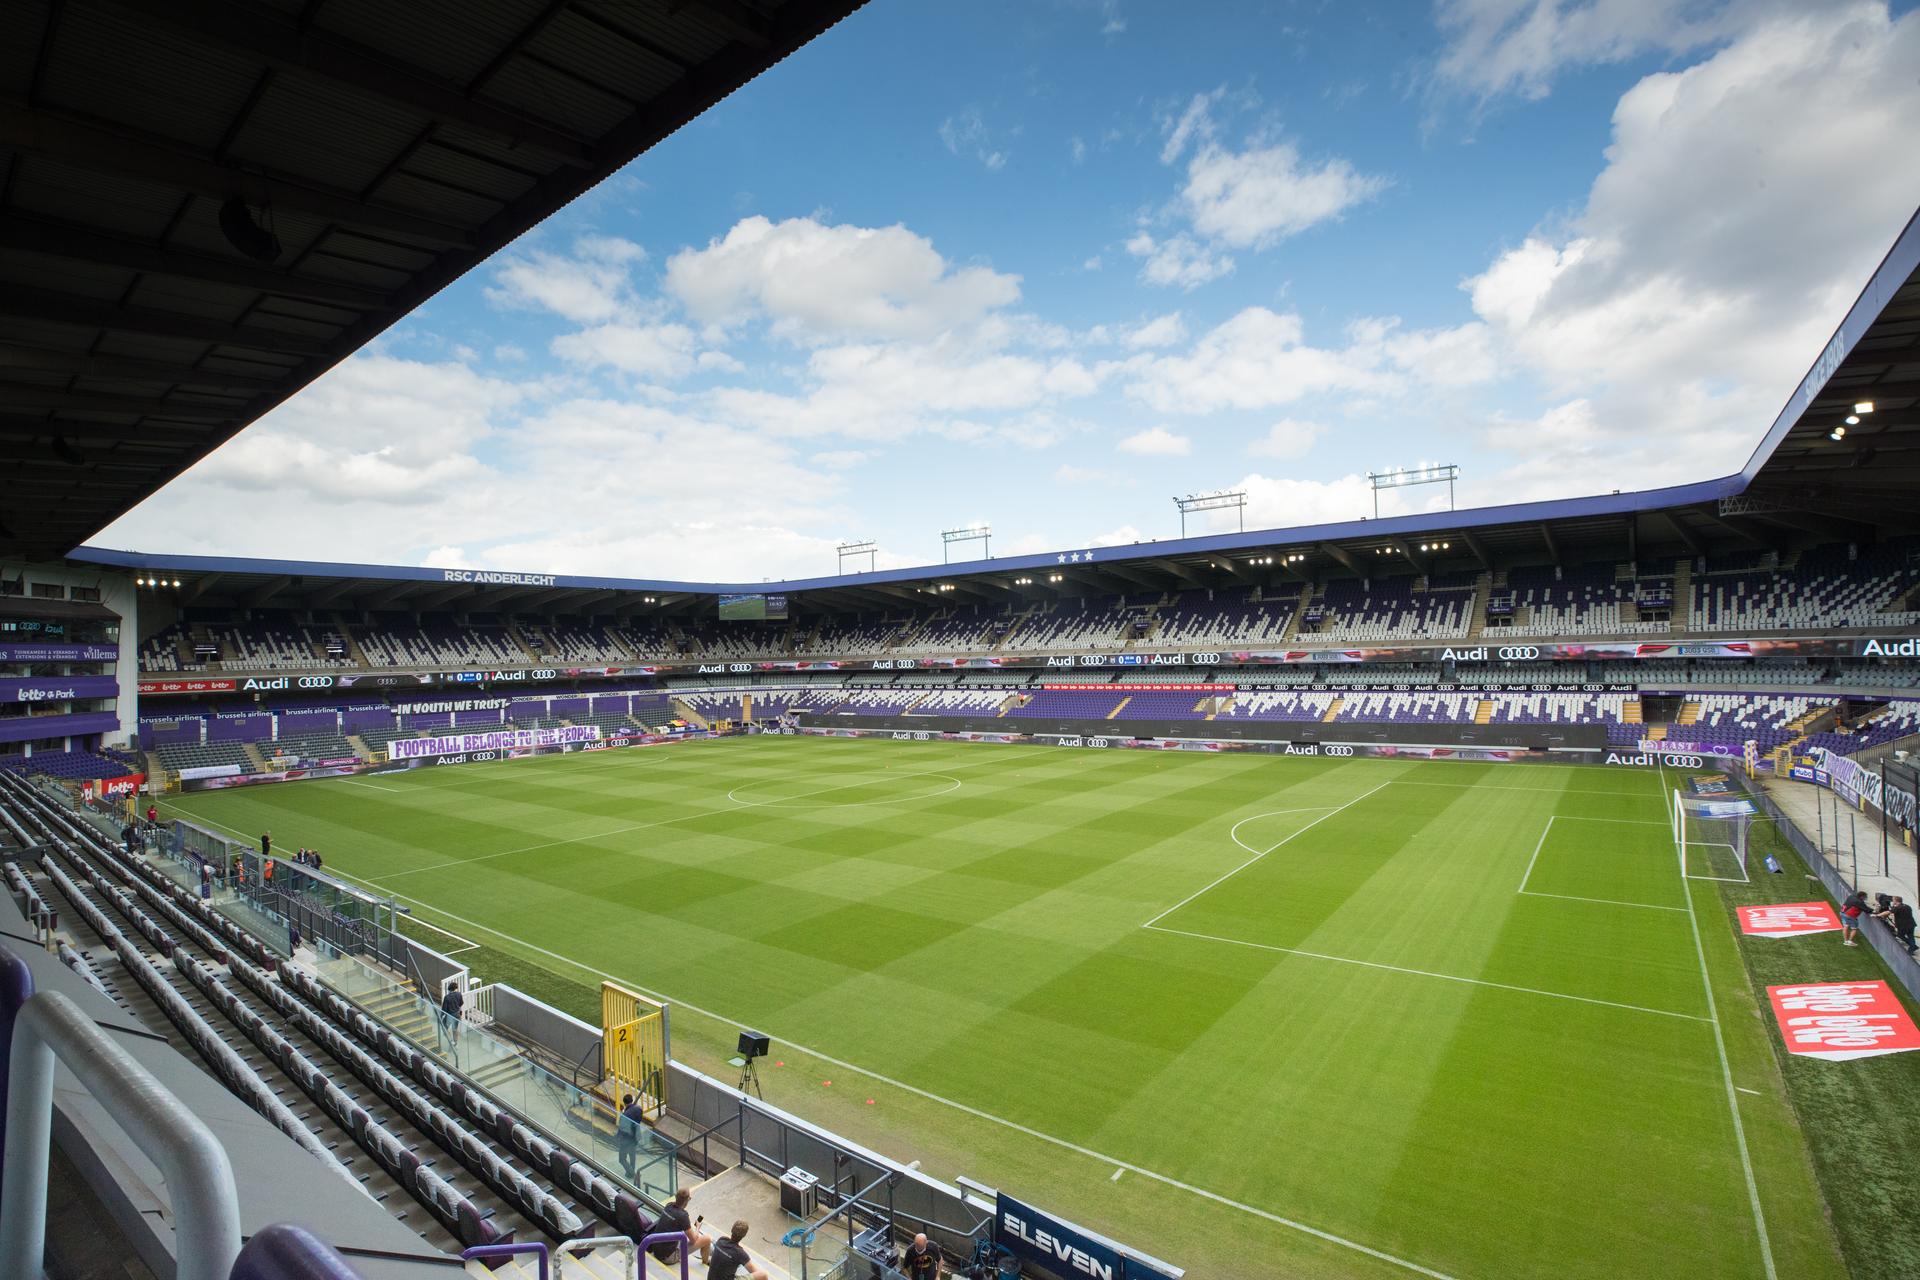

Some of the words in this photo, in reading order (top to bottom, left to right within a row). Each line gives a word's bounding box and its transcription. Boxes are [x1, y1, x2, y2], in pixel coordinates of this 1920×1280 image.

[1826, 330, 1844, 377] 1908
[444, 570, 472, 582] RSC
[474, 572, 555, 586] ANDERLECHT
[83, 646, 117, 659] willems
[1862, 638, 1920, 656] Audi
[1153, 654, 1185, 664] Audi
[1441, 647, 1488, 660] Audi
[872, 660, 894, 669] Audi
[1047, 656, 1075, 666] Audi
[698, 664, 725, 673] Audi
[494, 670, 526, 680] Audi
[243, 678, 289, 690] Audi
[55, 688, 76, 699] Park
[286, 708, 313, 716] brussels
[314, 706, 338, 714] airlines
[397, 703, 411, 715] IN
[413, 701, 452, 714] YOUTH
[454, 700, 472, 711] WE
[473, 698, 507, 710] TRUST
[140, 716, 173, 724] brussels
[216, 712, 247, 720] brussels
[892, 732, 911, 740] Audi
[395, 736, 461, 758] FOOTBALL
[463, 732, 516, 752] BELONGS
[517, 730, 532, 746] TO
[536, 728, 557, 744] THE
[558, 726, 596, 743] PEOPLE
[583, 741, 607, 750] Audi
[1058, 738, 1083, 747] Audi
[1662, 740, 1693, 751] EAST
[1285, 744, 1318, 755] Audi
[436, 754, 467, 765] Audi
[1605, 752, 1654, 766] Audi
[1795, 769, 1812, 778] Hubo
[619, 1028, 627, 1042] 2
[1004, 1212, 1112, 1280] ELEVEN
